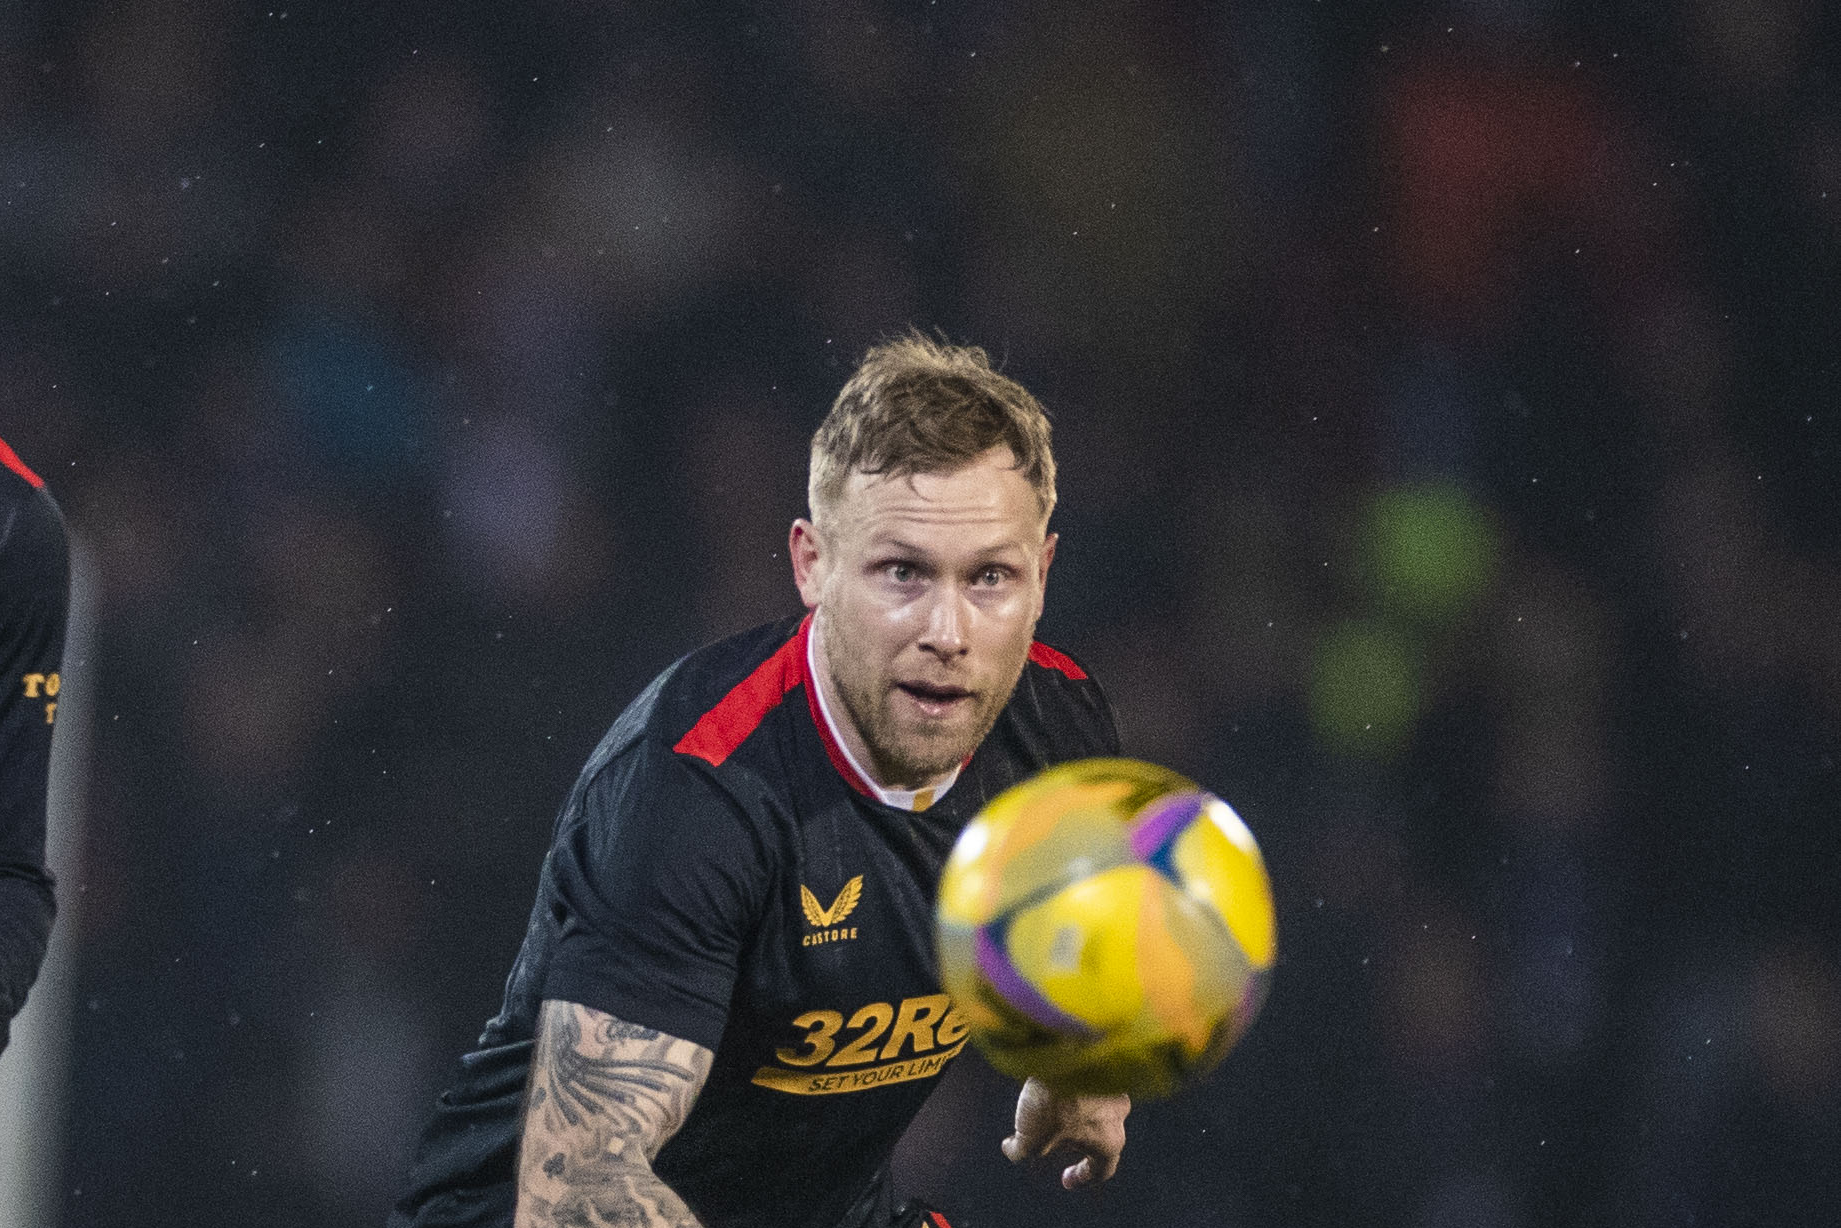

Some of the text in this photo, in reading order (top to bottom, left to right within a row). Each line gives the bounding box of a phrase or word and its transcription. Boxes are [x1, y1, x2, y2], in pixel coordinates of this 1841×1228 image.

[802, 927, 858, 947] CASTORE
[776, 994, 971, 1067] 32Re
[808, 1075, 849, 1092] SET
[852, 1064, 905, 1086] YOUR
